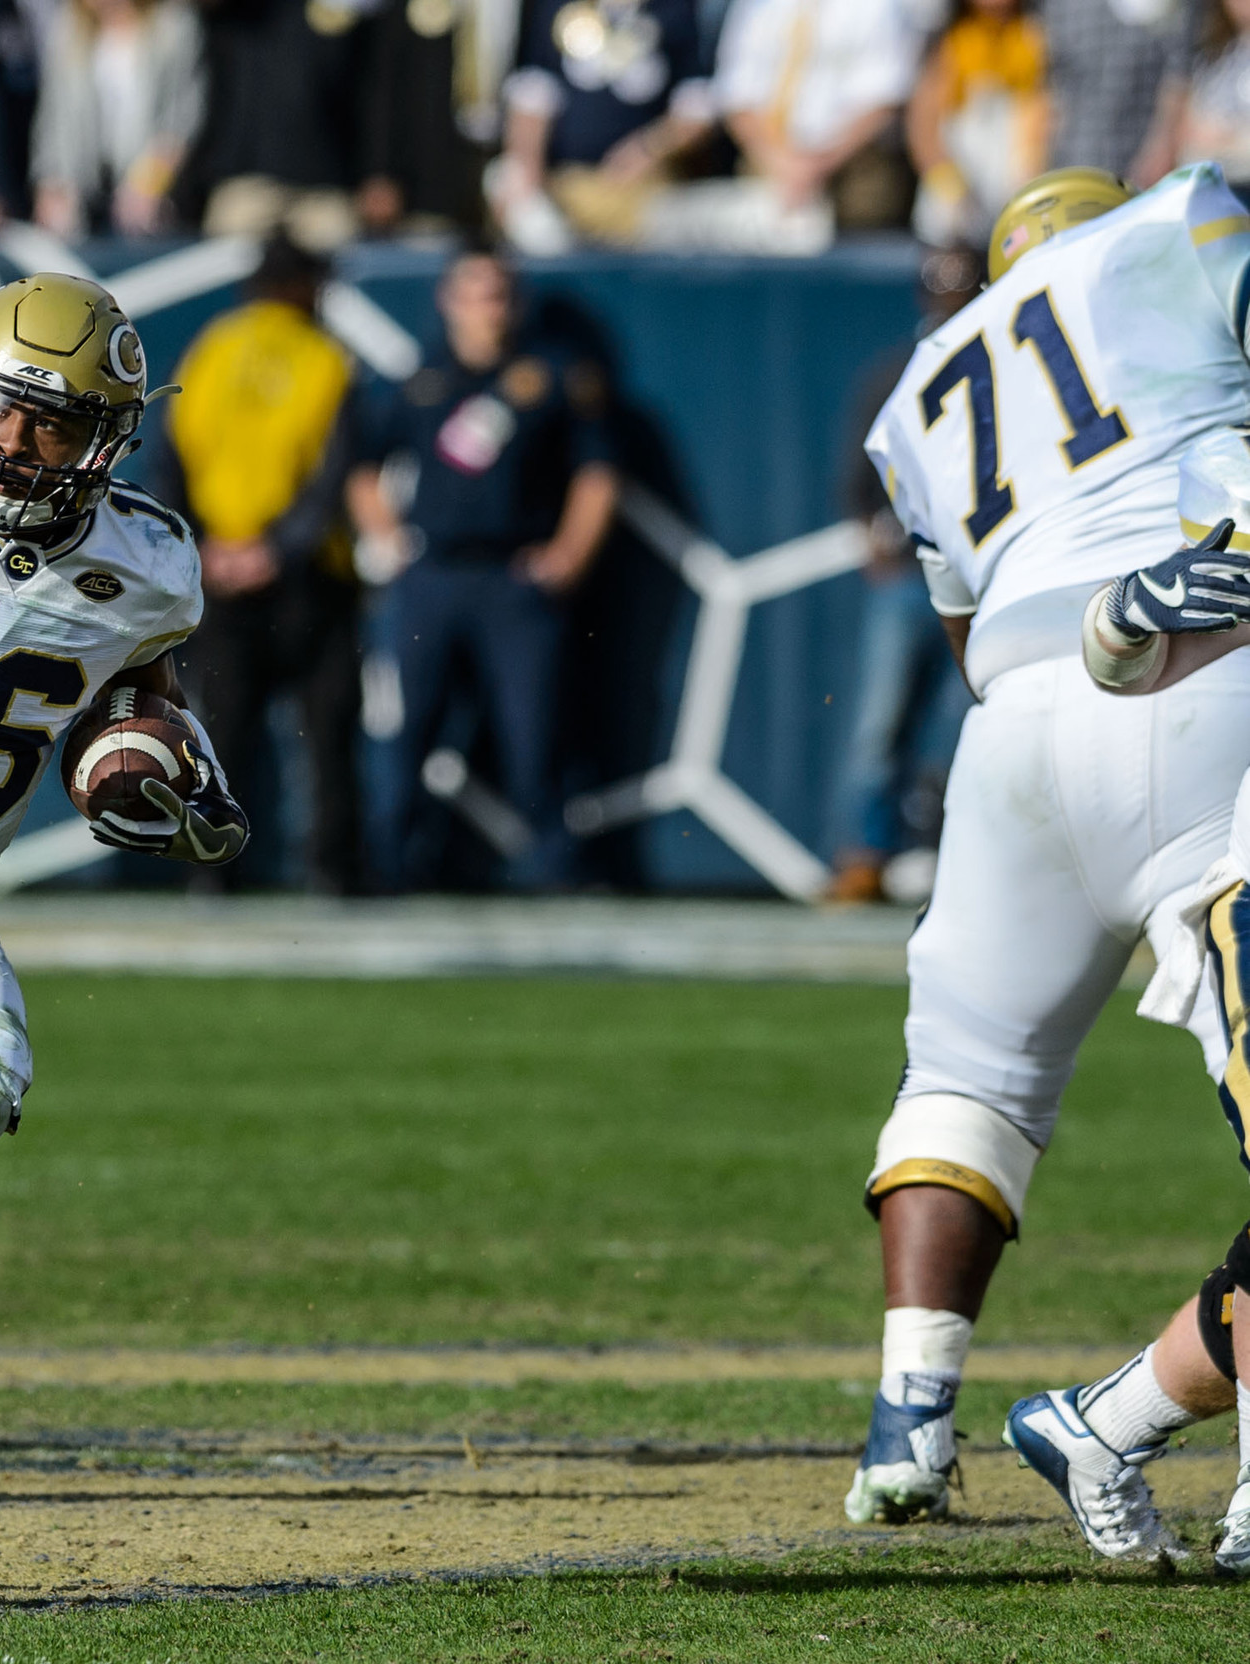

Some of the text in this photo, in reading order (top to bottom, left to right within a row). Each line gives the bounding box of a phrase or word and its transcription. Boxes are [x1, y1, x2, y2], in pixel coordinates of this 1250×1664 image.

[16, 364, 55, 382] ACC
[918, 286, 1134, 555] 71
[8, 553, 35, 574] GT
[80, 576, 120, 593] ACC
